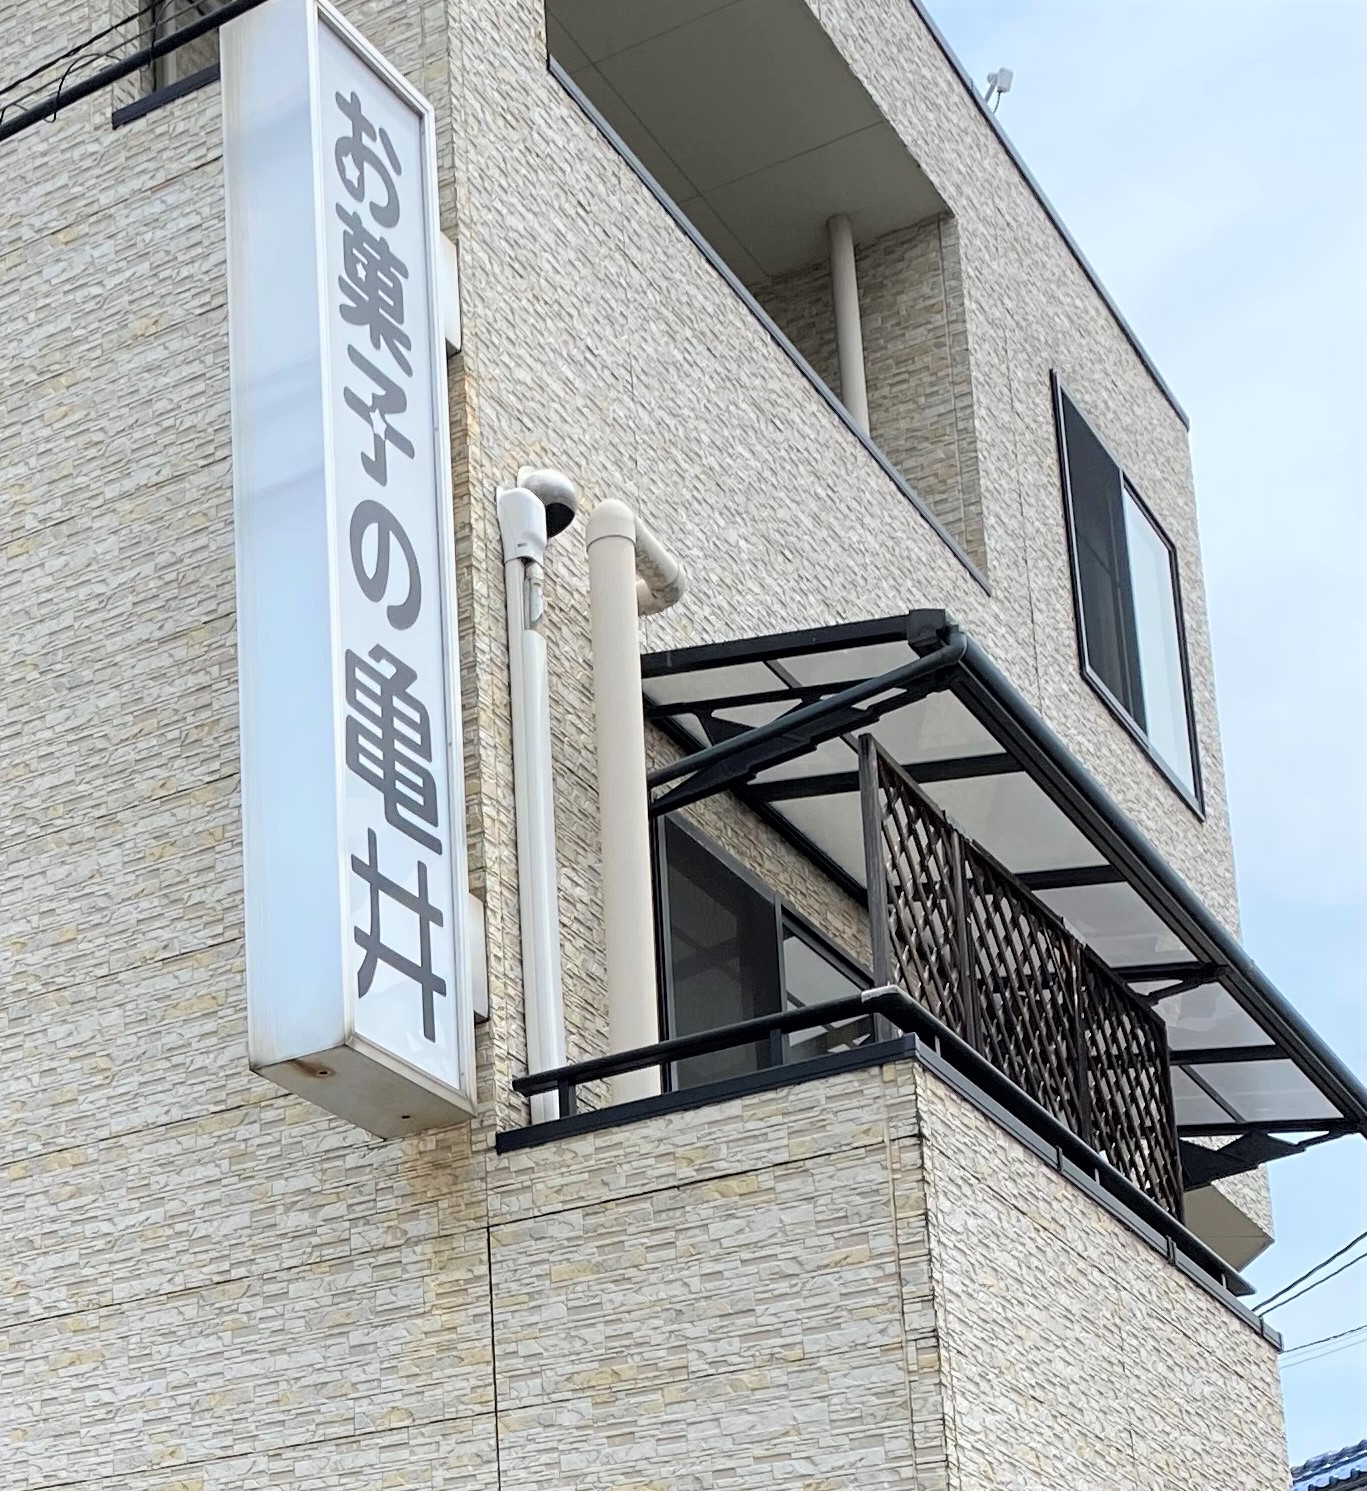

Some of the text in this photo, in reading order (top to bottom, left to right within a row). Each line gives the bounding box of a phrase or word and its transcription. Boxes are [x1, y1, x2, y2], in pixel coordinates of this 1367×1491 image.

[333, 89, 447, 1045] お菓子の亀井
